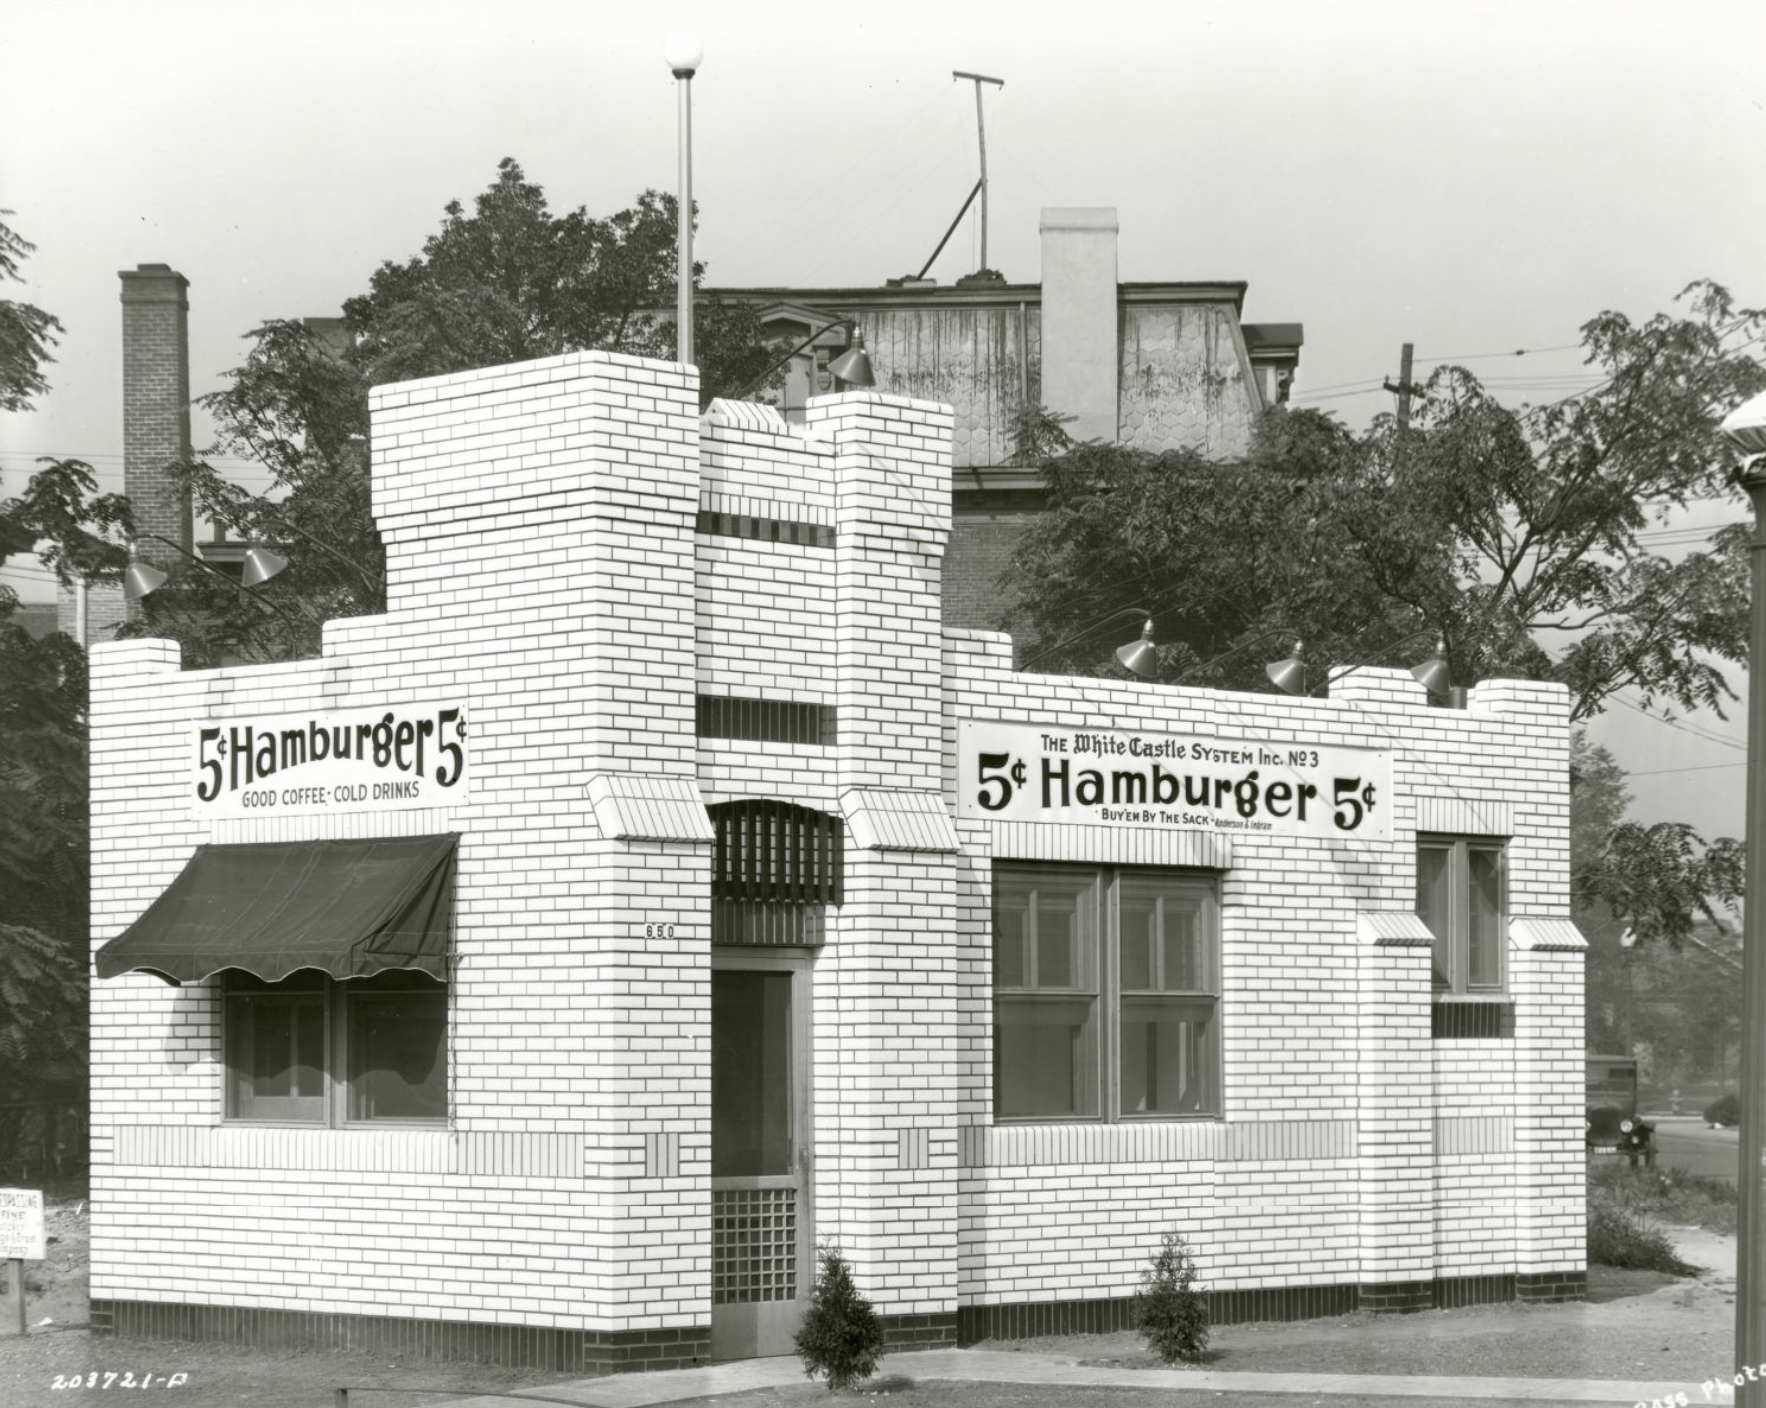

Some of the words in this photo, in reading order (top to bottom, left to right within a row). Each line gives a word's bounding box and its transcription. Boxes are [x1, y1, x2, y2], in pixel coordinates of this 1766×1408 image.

[230, 712, 434, 792] Hamburger
[1041, 734, 1068, 752] THE
[1073, 733, 1126, 759] White
[1129, 737, 1187, 759] Castle
[1191, 743, 1253, 765] SYSTEM
[1258, 747, 1284, 766] Inc.
[242, 790, 277, 808] GOOD
[333, 783, 368, 803] COLD
[372, 780, 420, 801] DRINKS
[1041, 758, 1318, 822] Hamburger
[1142, 810, 1157, 823] BY
[1159, 811, 1180, 824] THE
[1182, 812, 1210, 825] SACK
[646, 925, 675, 938] 650
